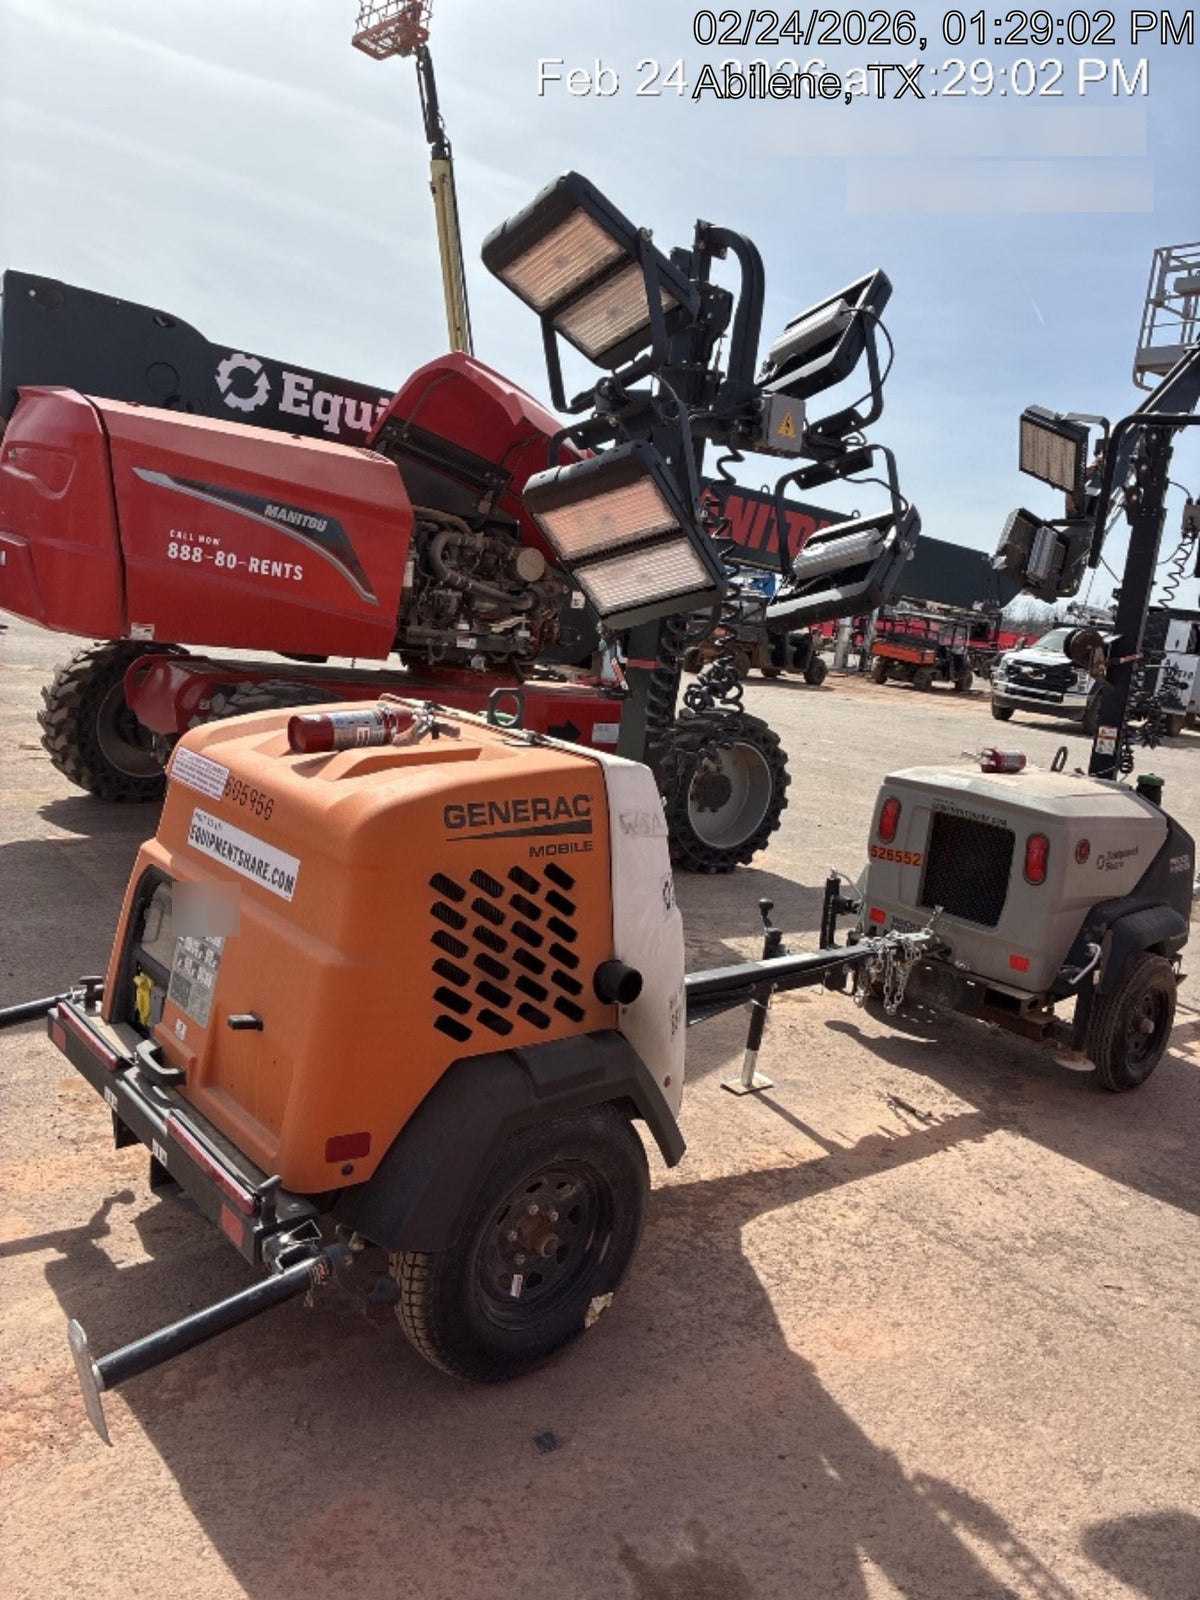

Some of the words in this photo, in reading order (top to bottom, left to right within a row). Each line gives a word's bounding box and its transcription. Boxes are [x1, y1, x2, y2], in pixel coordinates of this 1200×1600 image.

[264, 504, 328, 532] MANITOU
[169, 529, 194, 542] CALL
[198, 534, 221, 546] NOW
[167, 541, 304, 581] 888-80-RENTS
[443, 794, 592, 829] GENERAC
[189, 824, 296, 896] EQUIPMENTSHARE.COM
[528, 840, 594, 858] MOBILE
[870, 846, 921, 867] 526552
